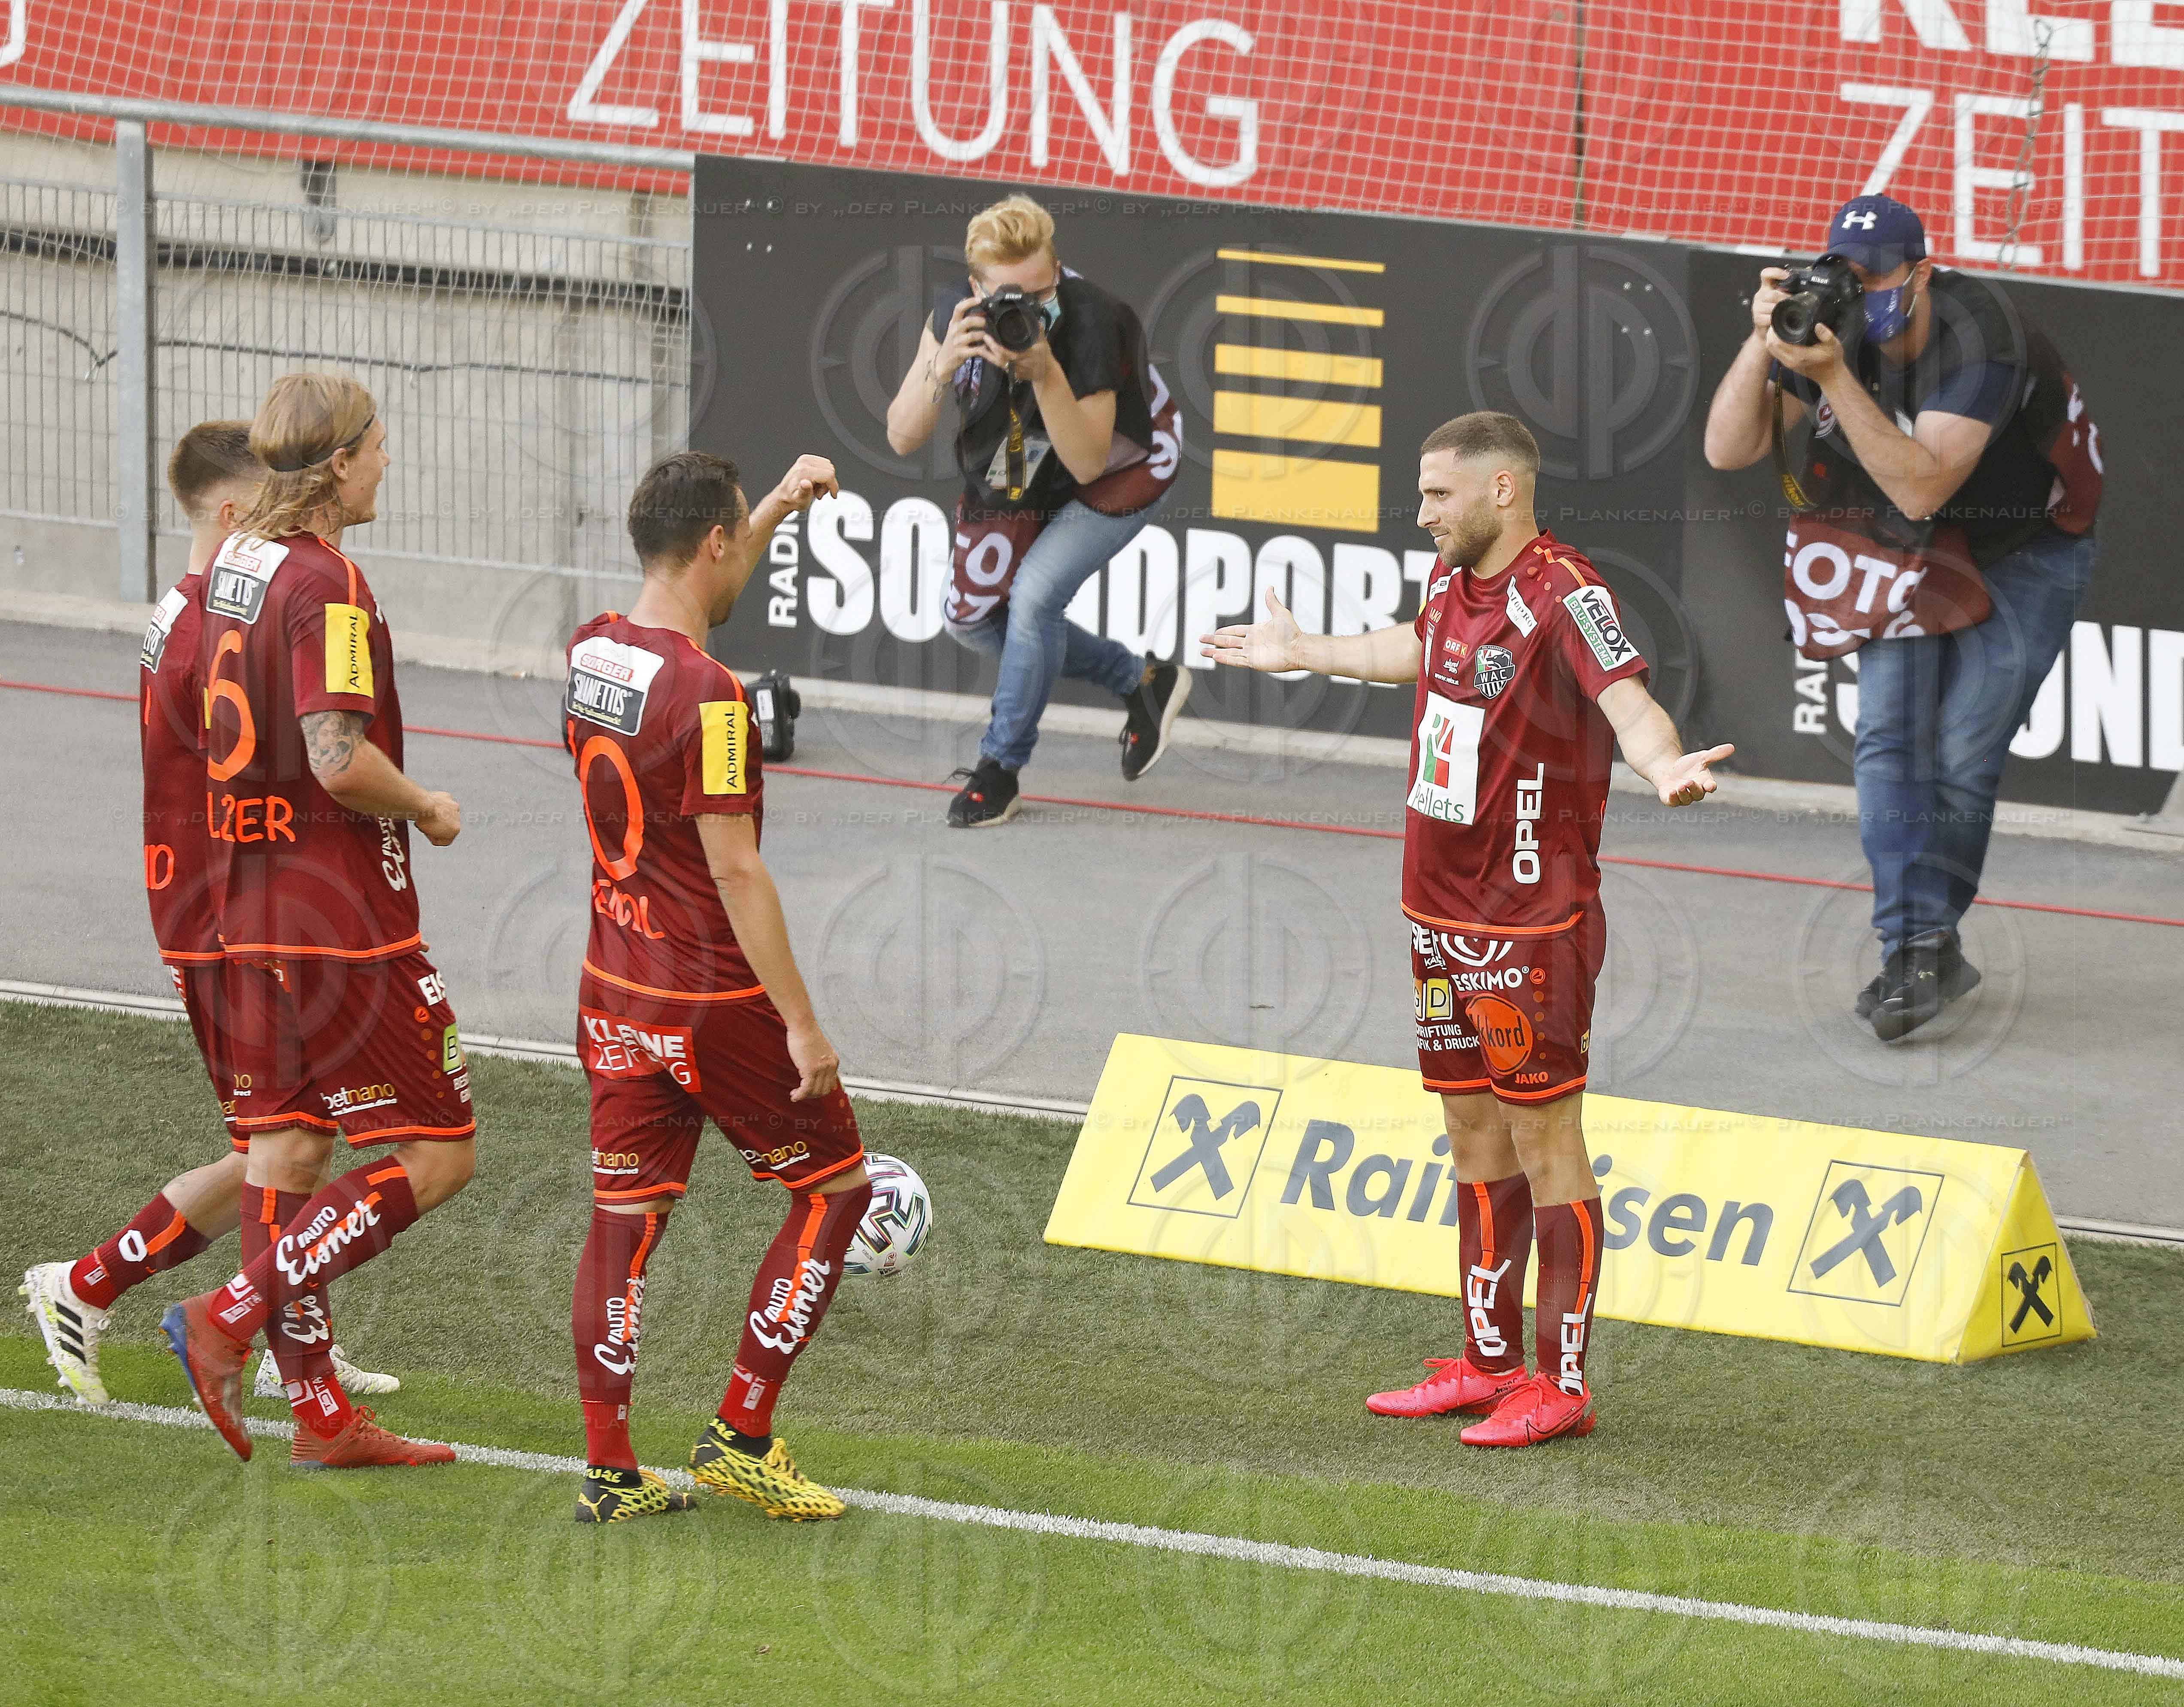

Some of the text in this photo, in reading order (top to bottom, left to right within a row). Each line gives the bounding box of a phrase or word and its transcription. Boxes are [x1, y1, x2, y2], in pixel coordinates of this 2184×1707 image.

[567, 0, 1258, 188] ZEITUNG
[349, 611, 360, 688] ADMIRAL
[1445, 639, 1460, 652] ORF
[1581, 589, 1632, 662] VELOX
[1480, 669, 1508, 683] WAC
[725, 706, 737, 788] ADMIRAL
[1512, 762, 1544, 885] OPEL
[1433, 1039, 1443, 1051] &
[1444, 1035, 1481, 1050] DRUCK
[1514, 1071, 1548, 1085] JAKO
[1467, 1259, 1511, 1357] OPEL
[1558, 1293, 1592, 1396] OPEL
